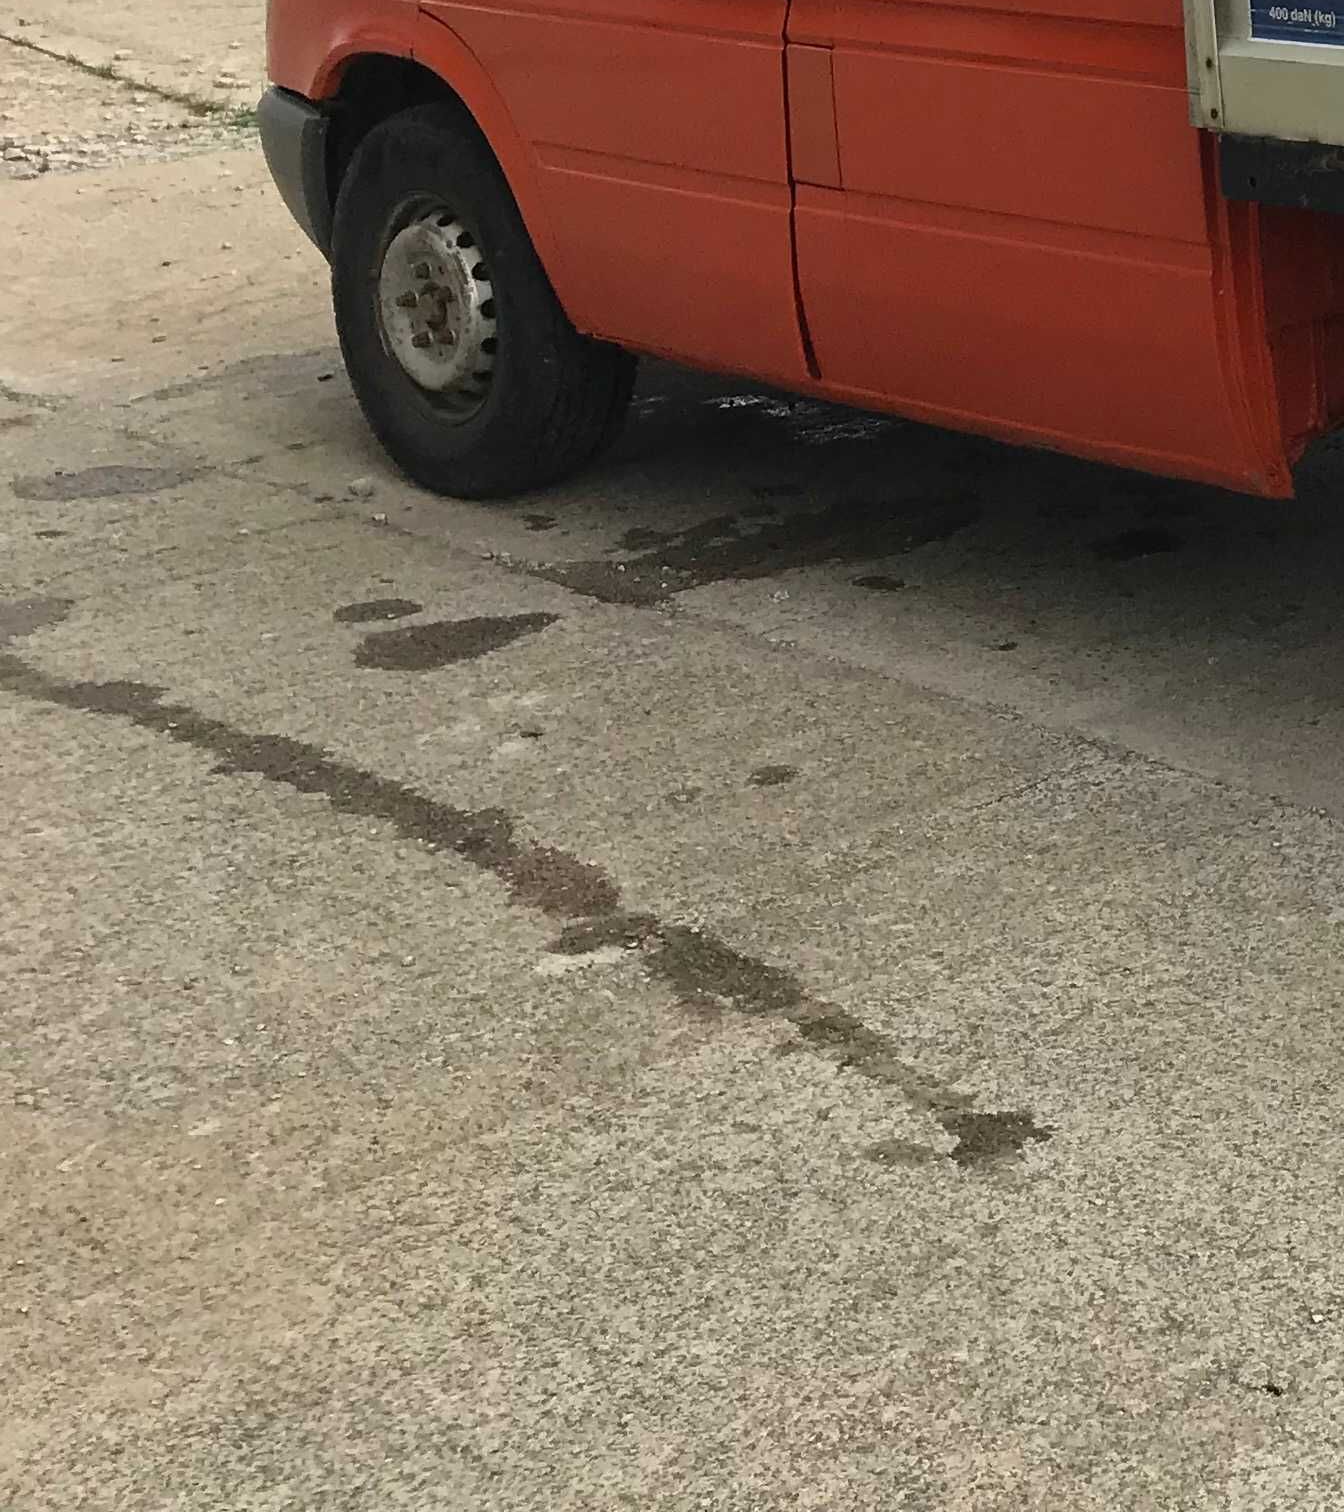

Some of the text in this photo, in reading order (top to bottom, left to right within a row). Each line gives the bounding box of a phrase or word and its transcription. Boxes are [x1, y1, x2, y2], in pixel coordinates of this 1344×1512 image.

[1269, 6, 1336, 27] 400 daN (kg)
